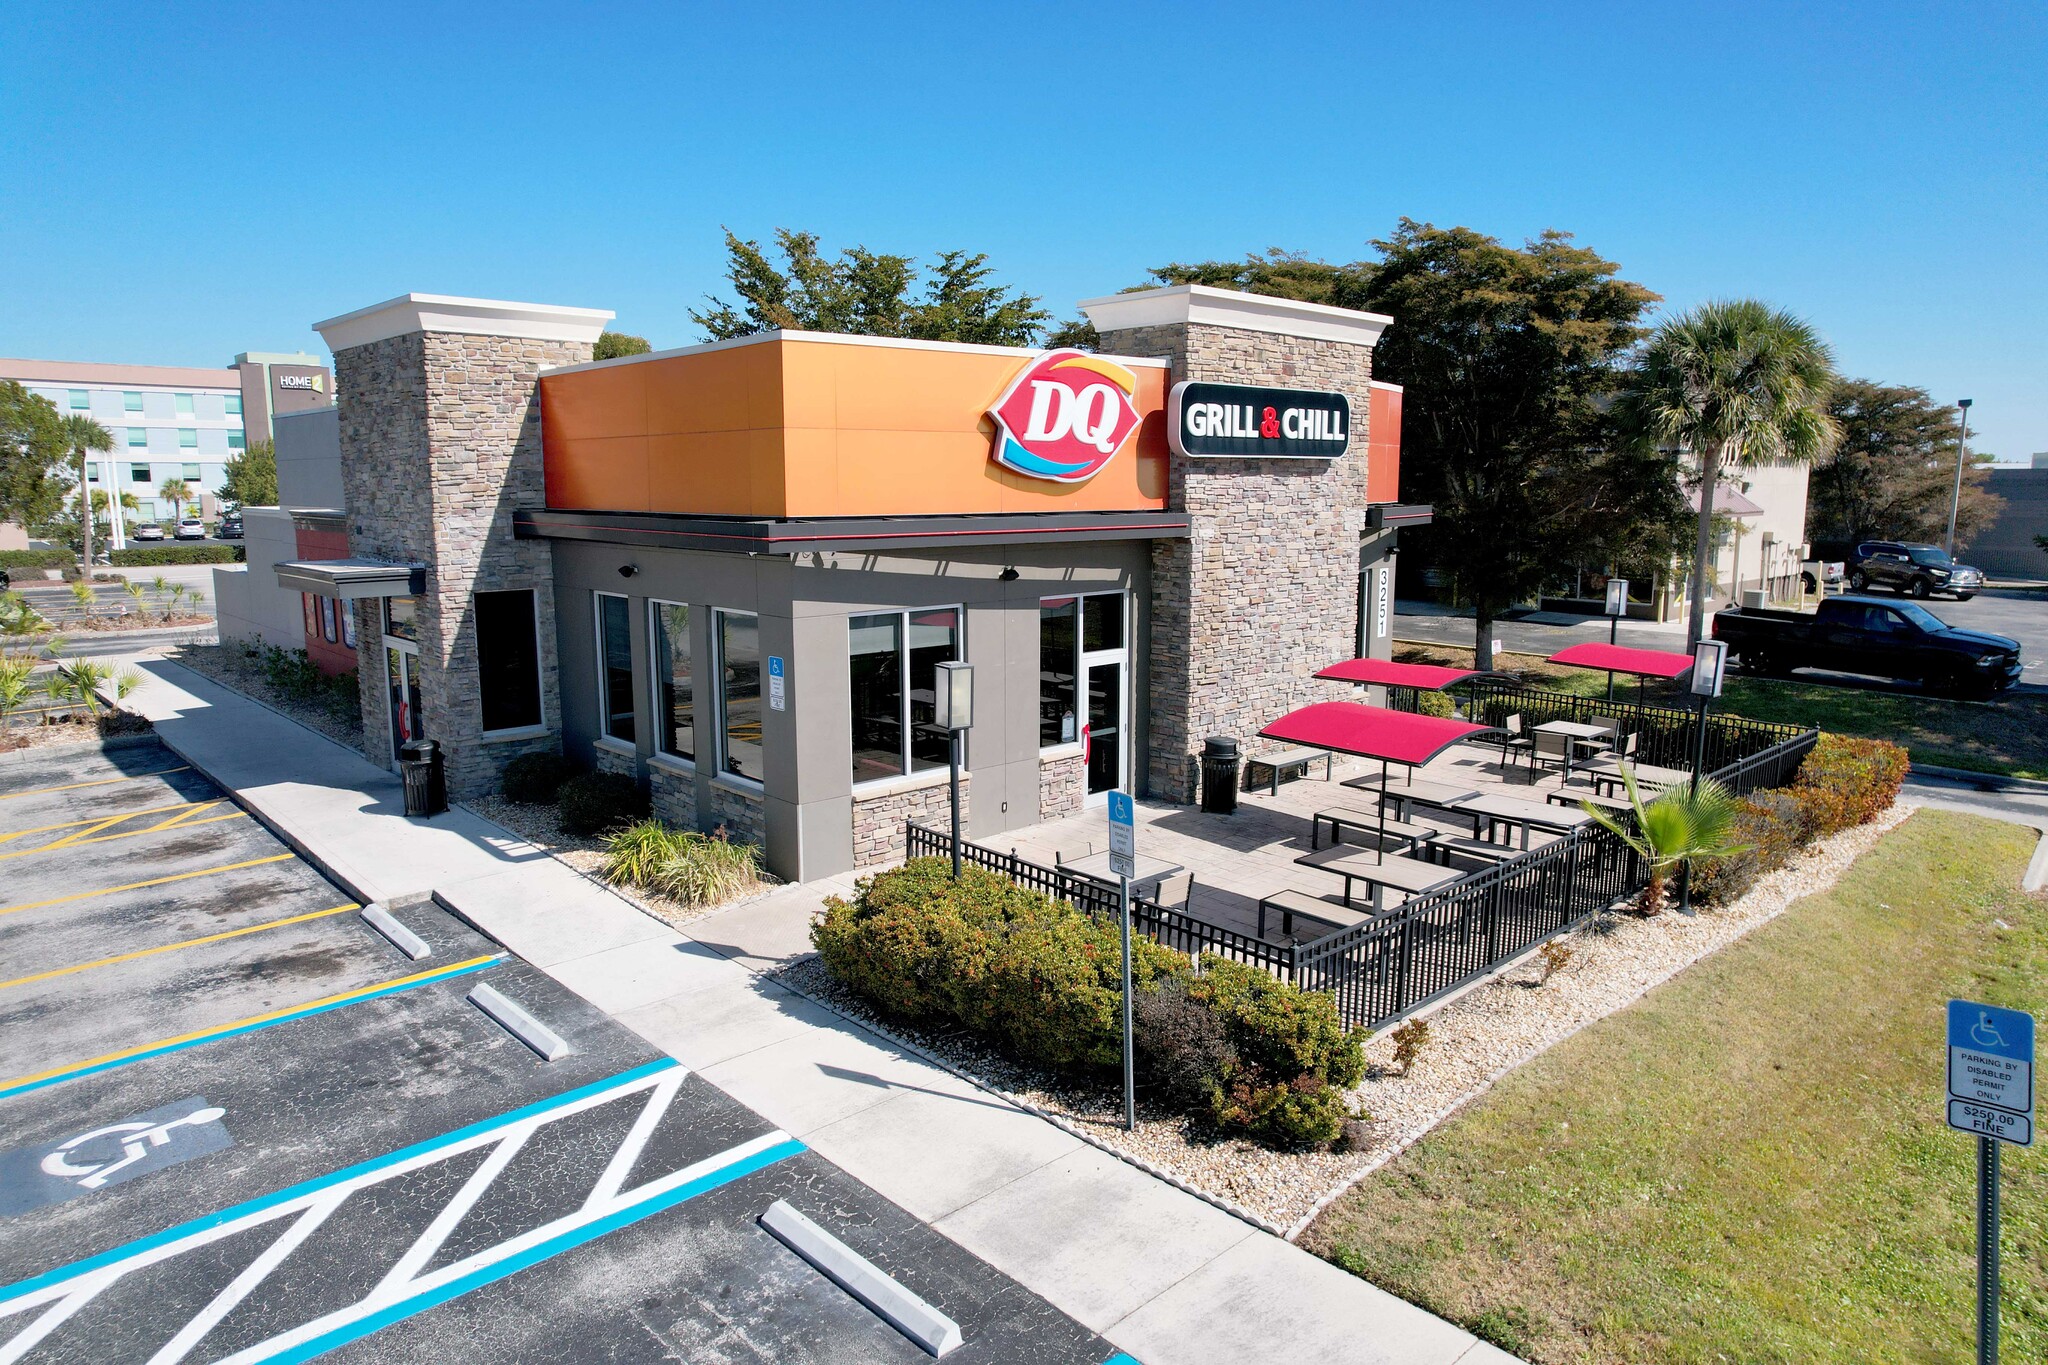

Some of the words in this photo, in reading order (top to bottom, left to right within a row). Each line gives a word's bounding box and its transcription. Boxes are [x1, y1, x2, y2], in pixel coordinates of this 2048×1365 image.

[280, 375, 312, 386] HOME
[1023, 380, 1120, 453] DQ
[1187, 403, 1259, 438] GRILL
[1261, 406, 1280, 439] &
[1282, 408, 1345, 441] CHILL
[1380, 570, 1388, 634] 3251
[1961, 1053, 2001, 1068] PARKING
[2005, 1062, 2018, 1071] BY
[1967, 1065, 2012, 1081] DISABLED
[1972, 1078, 2006, 1091] PERMIT
[1976, 1090, 2001, 1101] ONLY
[1963, 1106, 2015, 1126] $250.00
[1973, 1120, 2005, 1135] FINE
